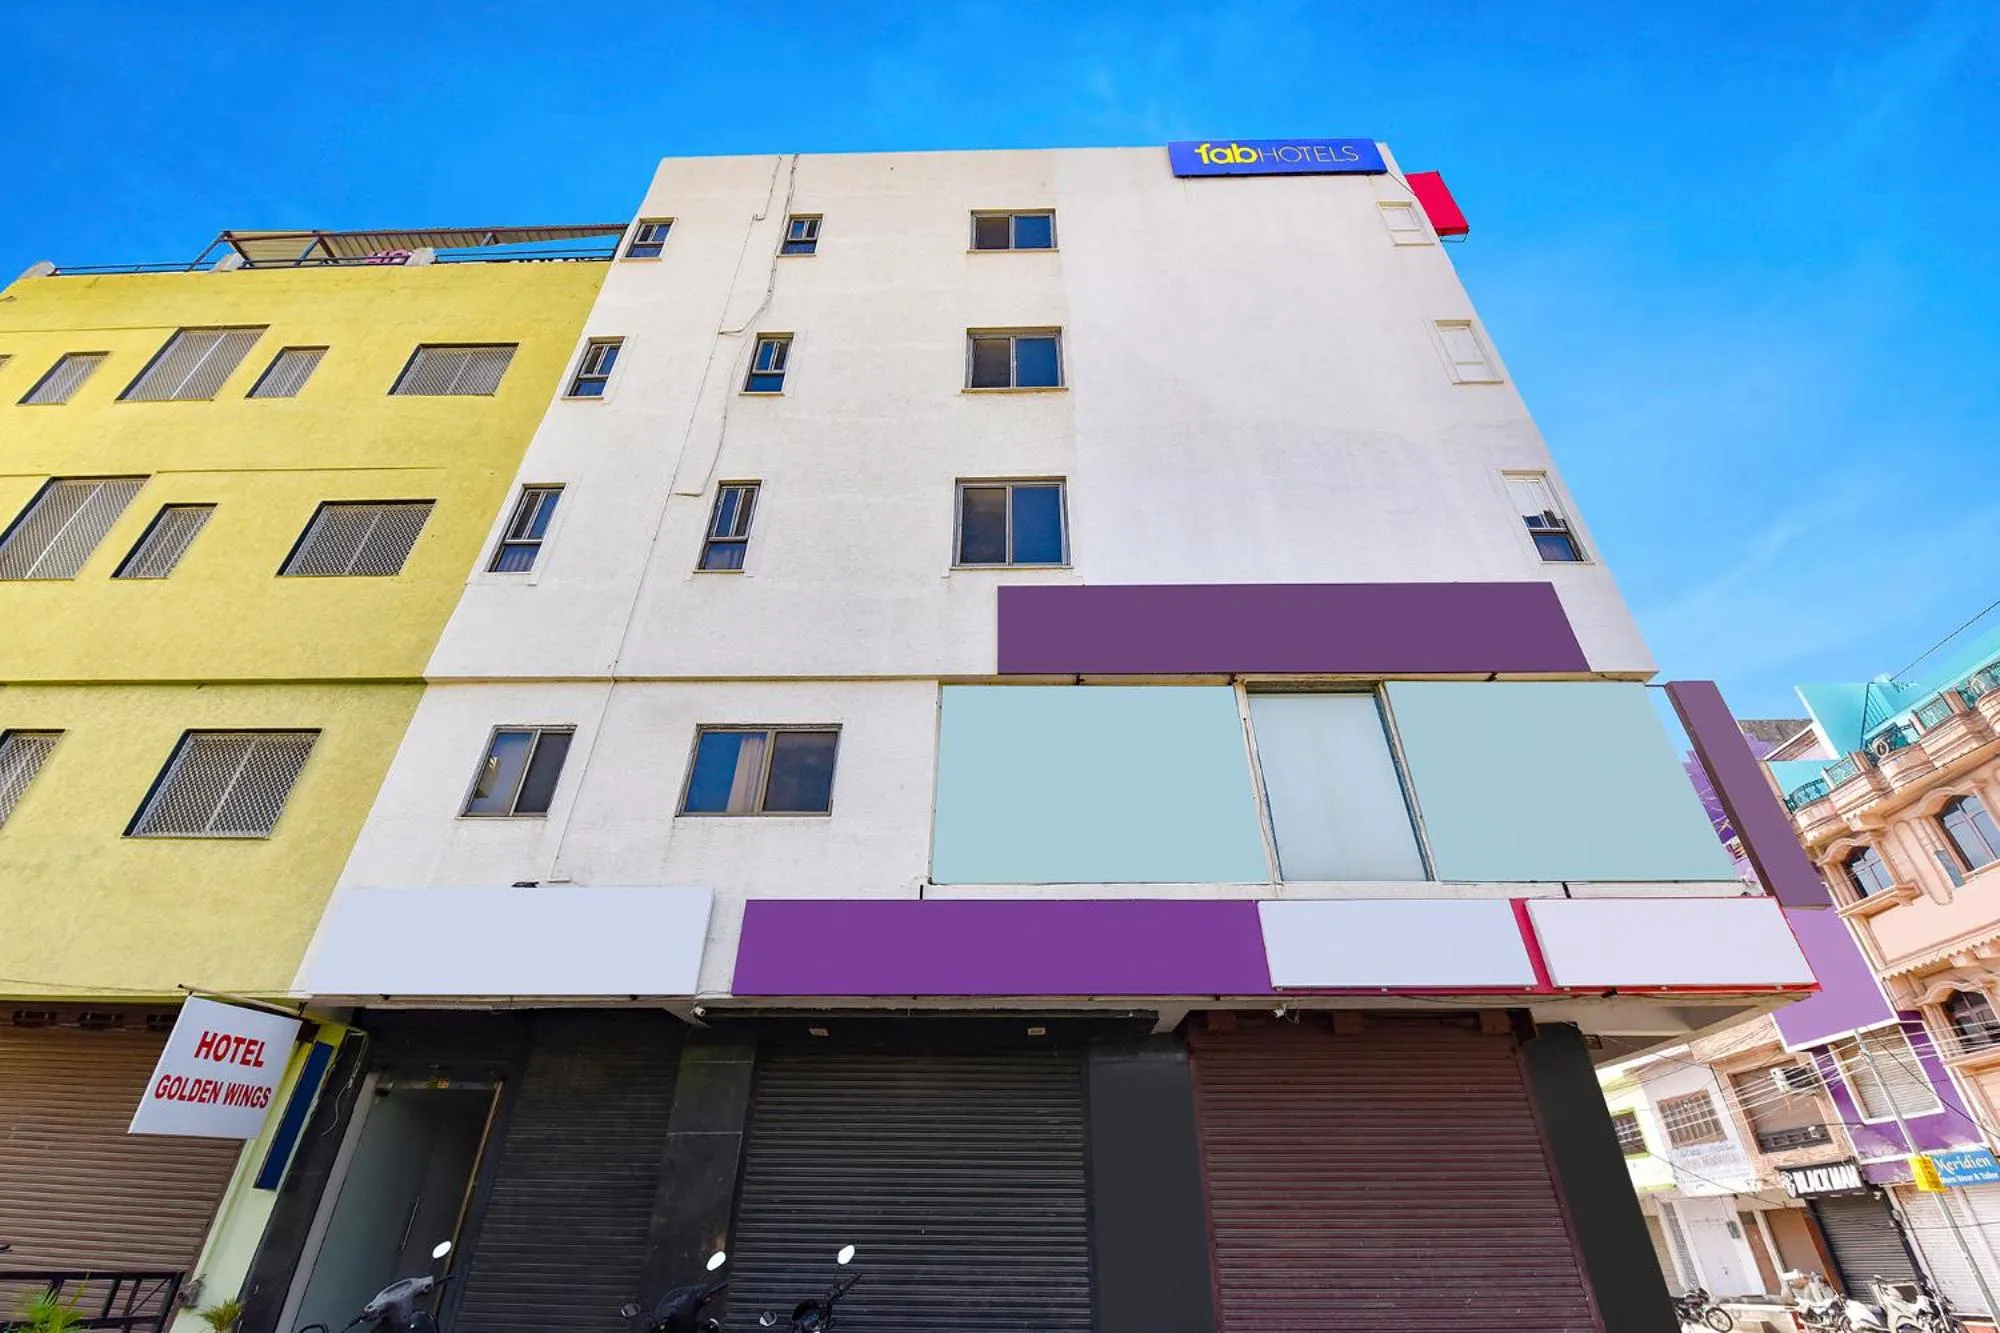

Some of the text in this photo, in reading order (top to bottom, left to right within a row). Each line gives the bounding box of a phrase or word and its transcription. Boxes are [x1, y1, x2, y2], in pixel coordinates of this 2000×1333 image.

[194, 1031, 266, 1068] HOTEL
[154, 1075, 272, 1109] GOLDEN WINGS
